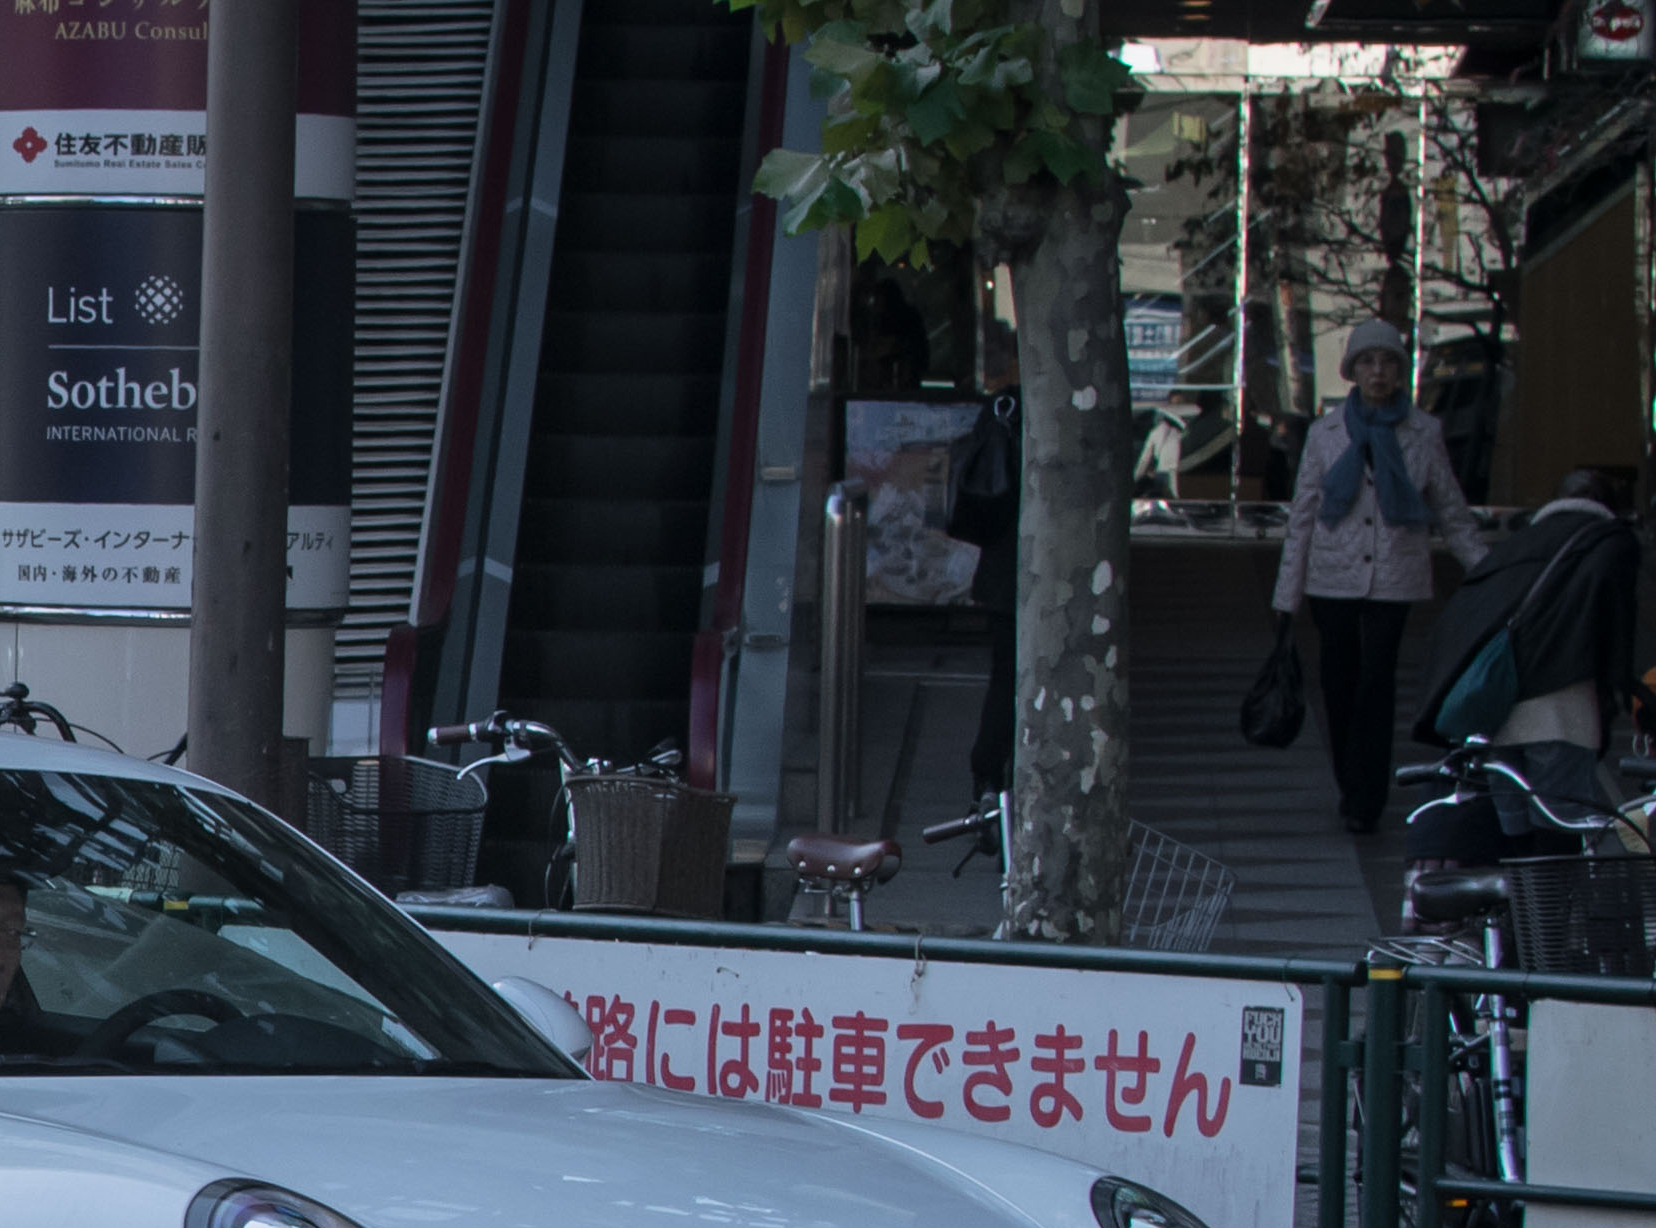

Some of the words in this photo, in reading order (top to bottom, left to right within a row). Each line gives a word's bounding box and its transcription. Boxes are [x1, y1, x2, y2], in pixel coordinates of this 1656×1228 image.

[54, 21, 126, 40] AZABU
[103, 159, 126, 169] Real
[128, 159, 161, 169] Estate
[164, 159, 192, 169] Sales
[48, 286, 114, 324] List
[46, 426, 182, 442] INTERNATIONAL
[564, 990, 1232, 1139] 路には駐車できません
